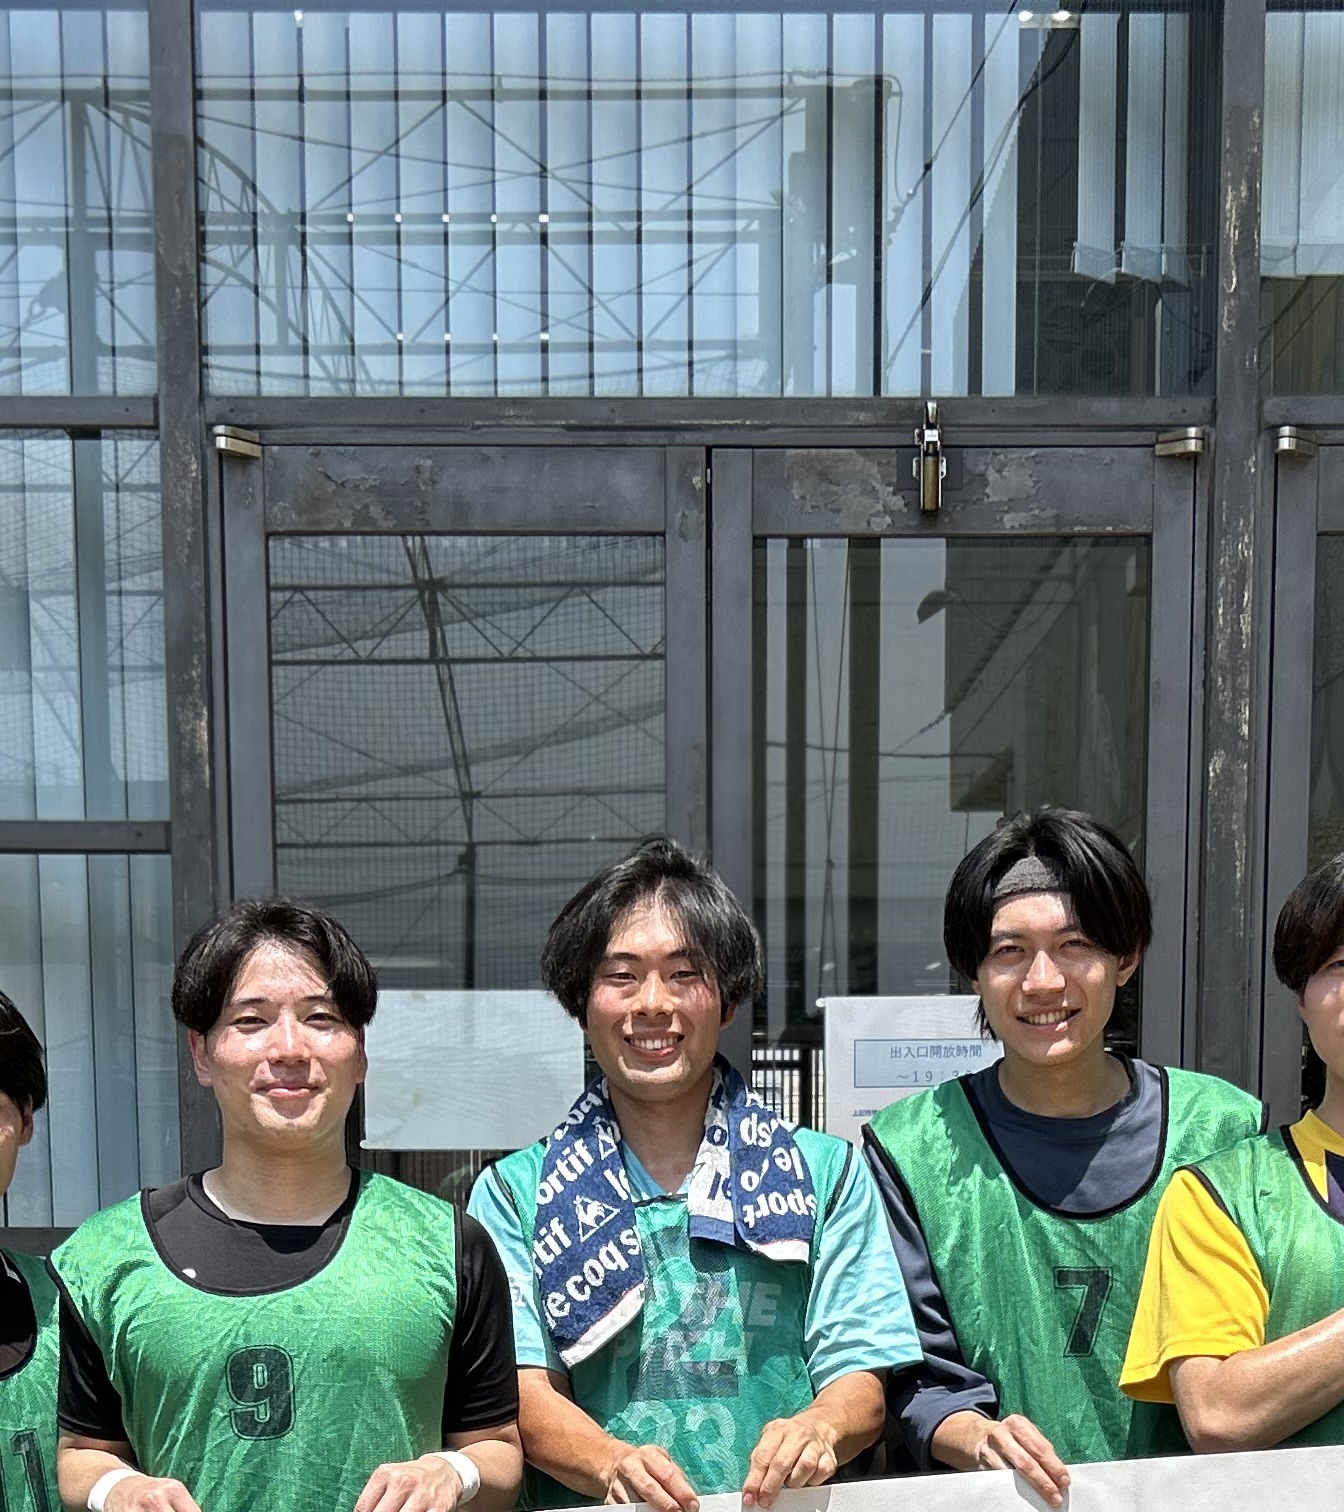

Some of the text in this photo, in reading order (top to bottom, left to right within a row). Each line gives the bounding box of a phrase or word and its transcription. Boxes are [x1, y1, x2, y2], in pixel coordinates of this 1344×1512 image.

[890, 1044, 982, 1059] 出入口開放時間
[1052, 1265, 1114, 1358] 7
[225, 1343, 296, 1441] 9
